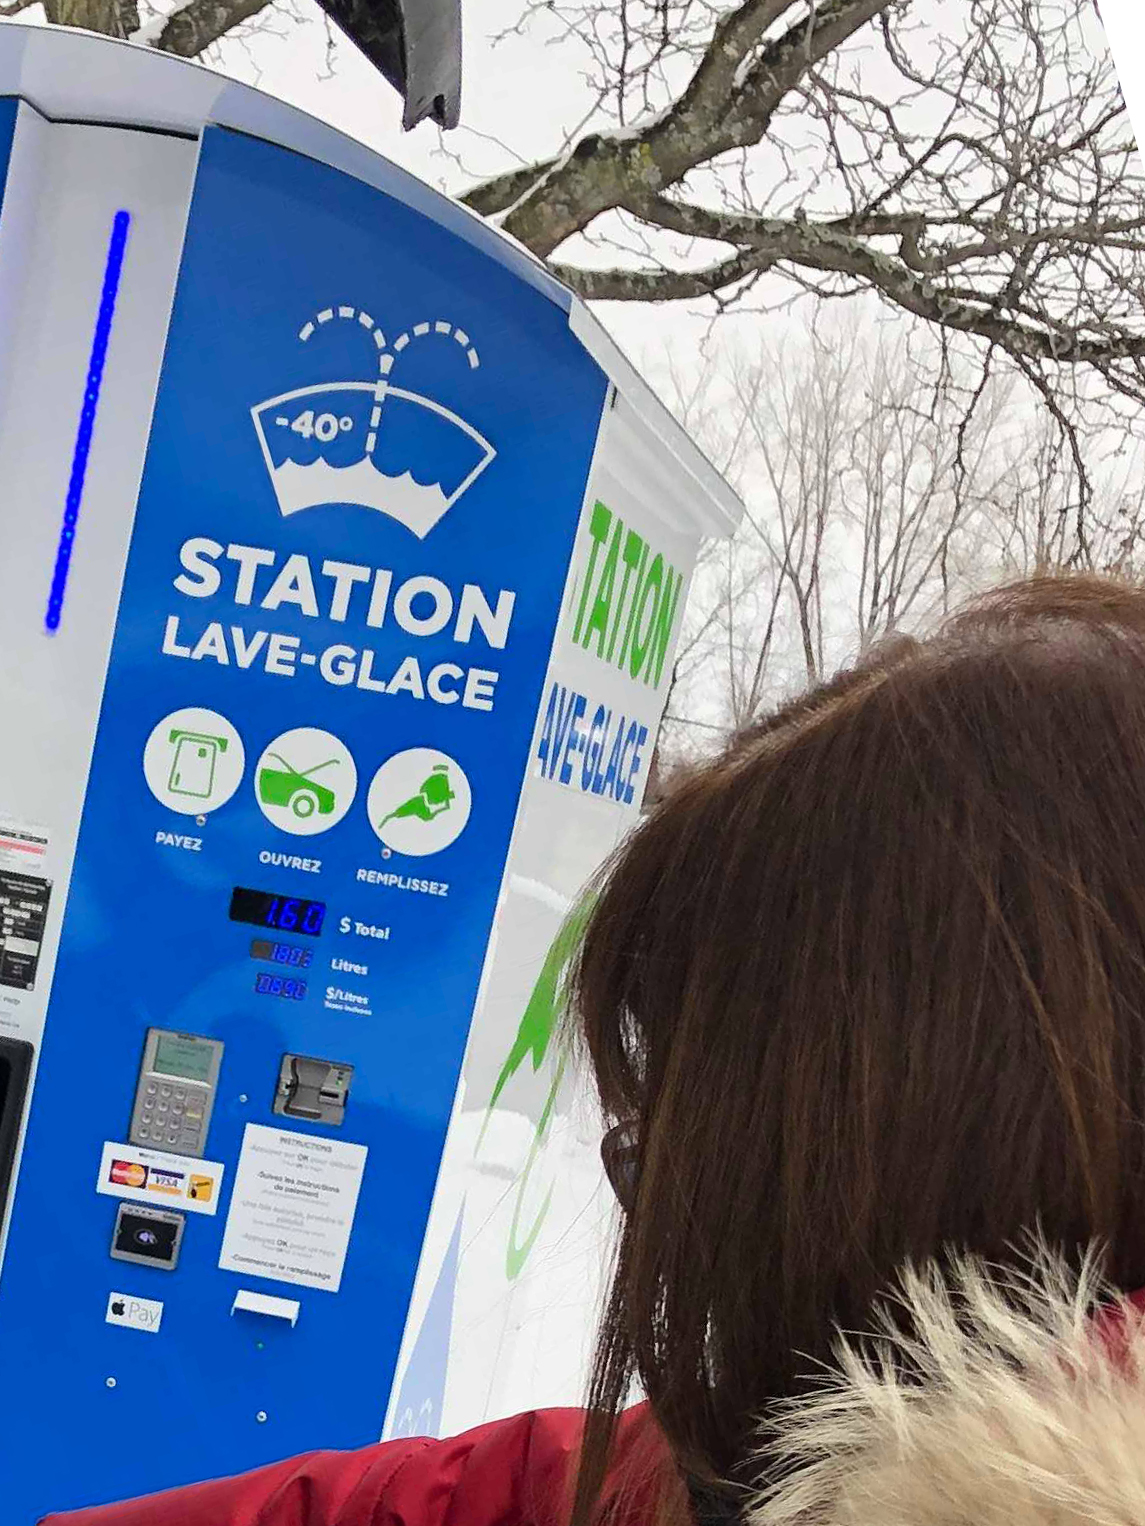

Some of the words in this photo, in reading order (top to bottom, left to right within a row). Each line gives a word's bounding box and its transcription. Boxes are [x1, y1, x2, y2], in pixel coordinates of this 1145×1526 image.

[172, 536, 516, 650] STATION
[162, 614, 501, 713] LAVE-GLACE
[155, 831, 203, 852] PAYEZ
[258, 849, 322, 874] OUVREZ
[356, 867, 449, 898] REMPLISSEZ
[339, 915, 352, 934] $
[354, 921, 391, 940] Total
[331, 958, 369, 976] Litres
[128, 1301, 160, 1326] Pay
